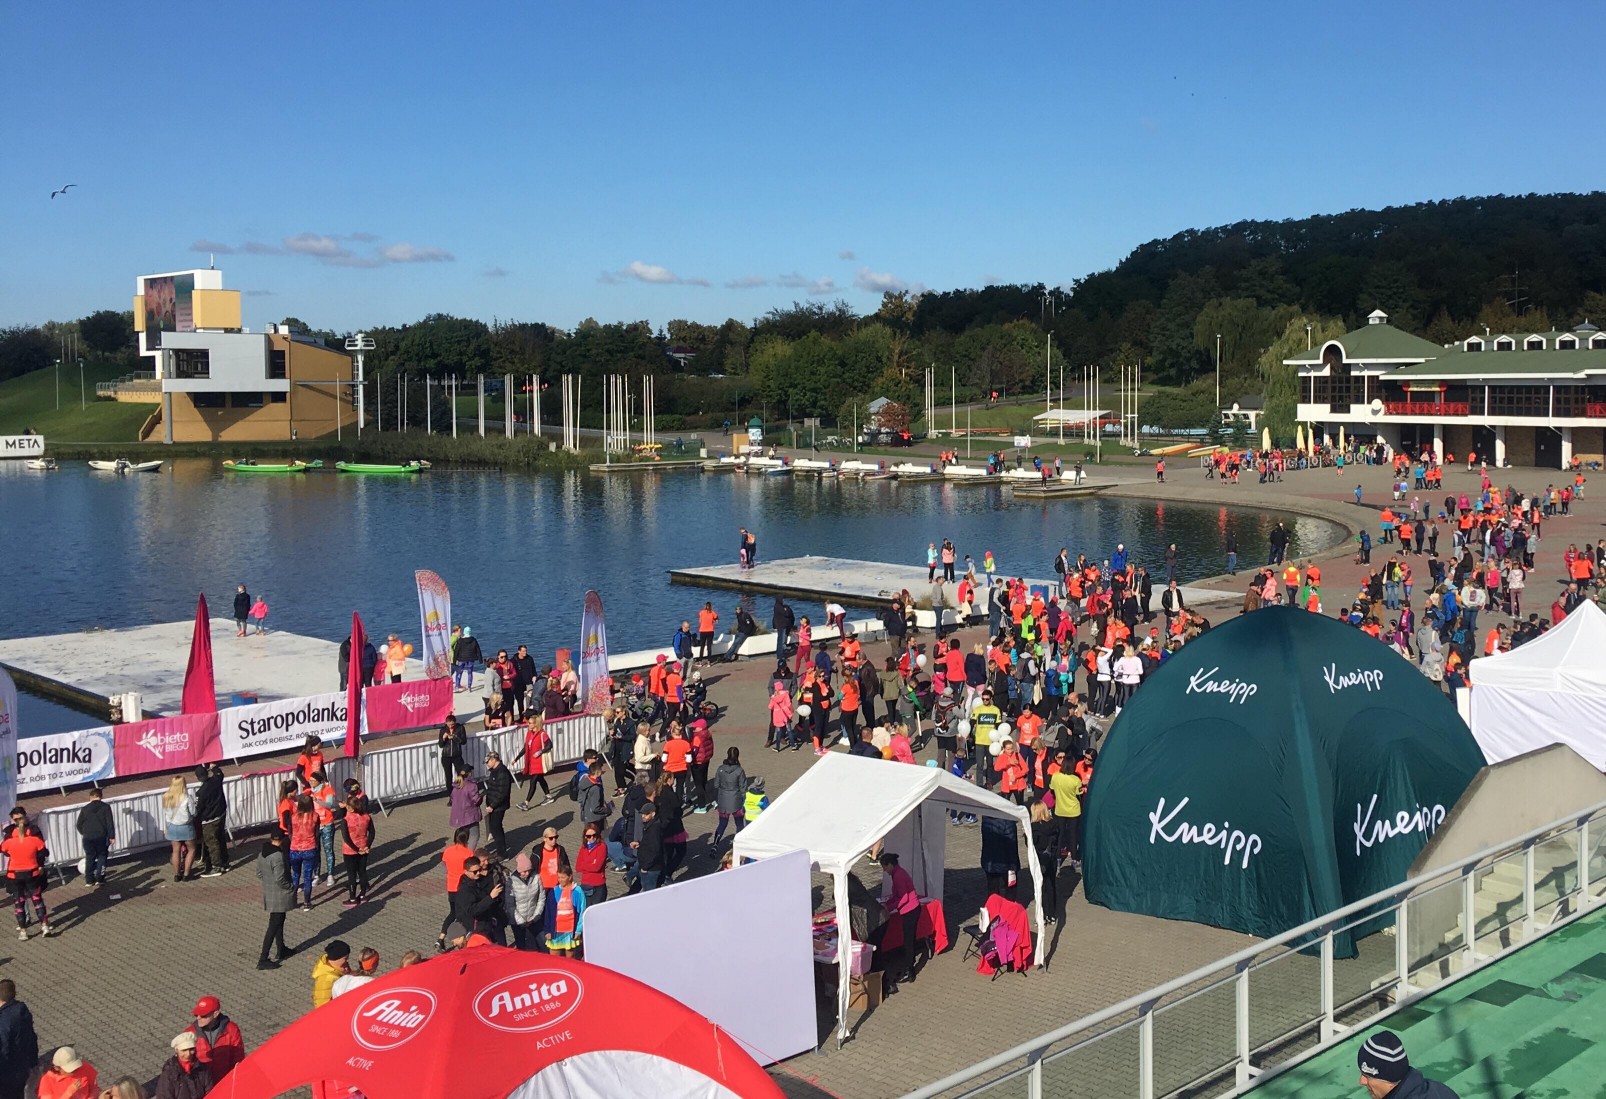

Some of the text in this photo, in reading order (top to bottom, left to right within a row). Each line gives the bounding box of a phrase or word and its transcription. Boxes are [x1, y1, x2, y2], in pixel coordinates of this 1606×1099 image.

[5, 439, 40, 449] META
[1186, 667, 1257, 704] Kneipp
[1323, 663, 1384, 693] Kneipp
[238, 701, 347, 739] Staropolanka
[165, 741, 190, 753] BIEGU
[241, 741, 254, 749] JAK
[47, 771, 58, 780] TO
[58, 770, 64, 778] Z
[1149, 797, 1262, 869] Kneipp
[1353, 794, 1445, 857] Kneipp
[488, 979, 568, 1018] Anita
[363, 999, 425, 1028] Anita
[513, 1001, 562, 1022] SINCE 1886
[368, 1024, 388, 1036] SINCE
[536, 1030, 573, 1051] ACTIVE
[345, 1056, 375, 1070] ACTIVE
